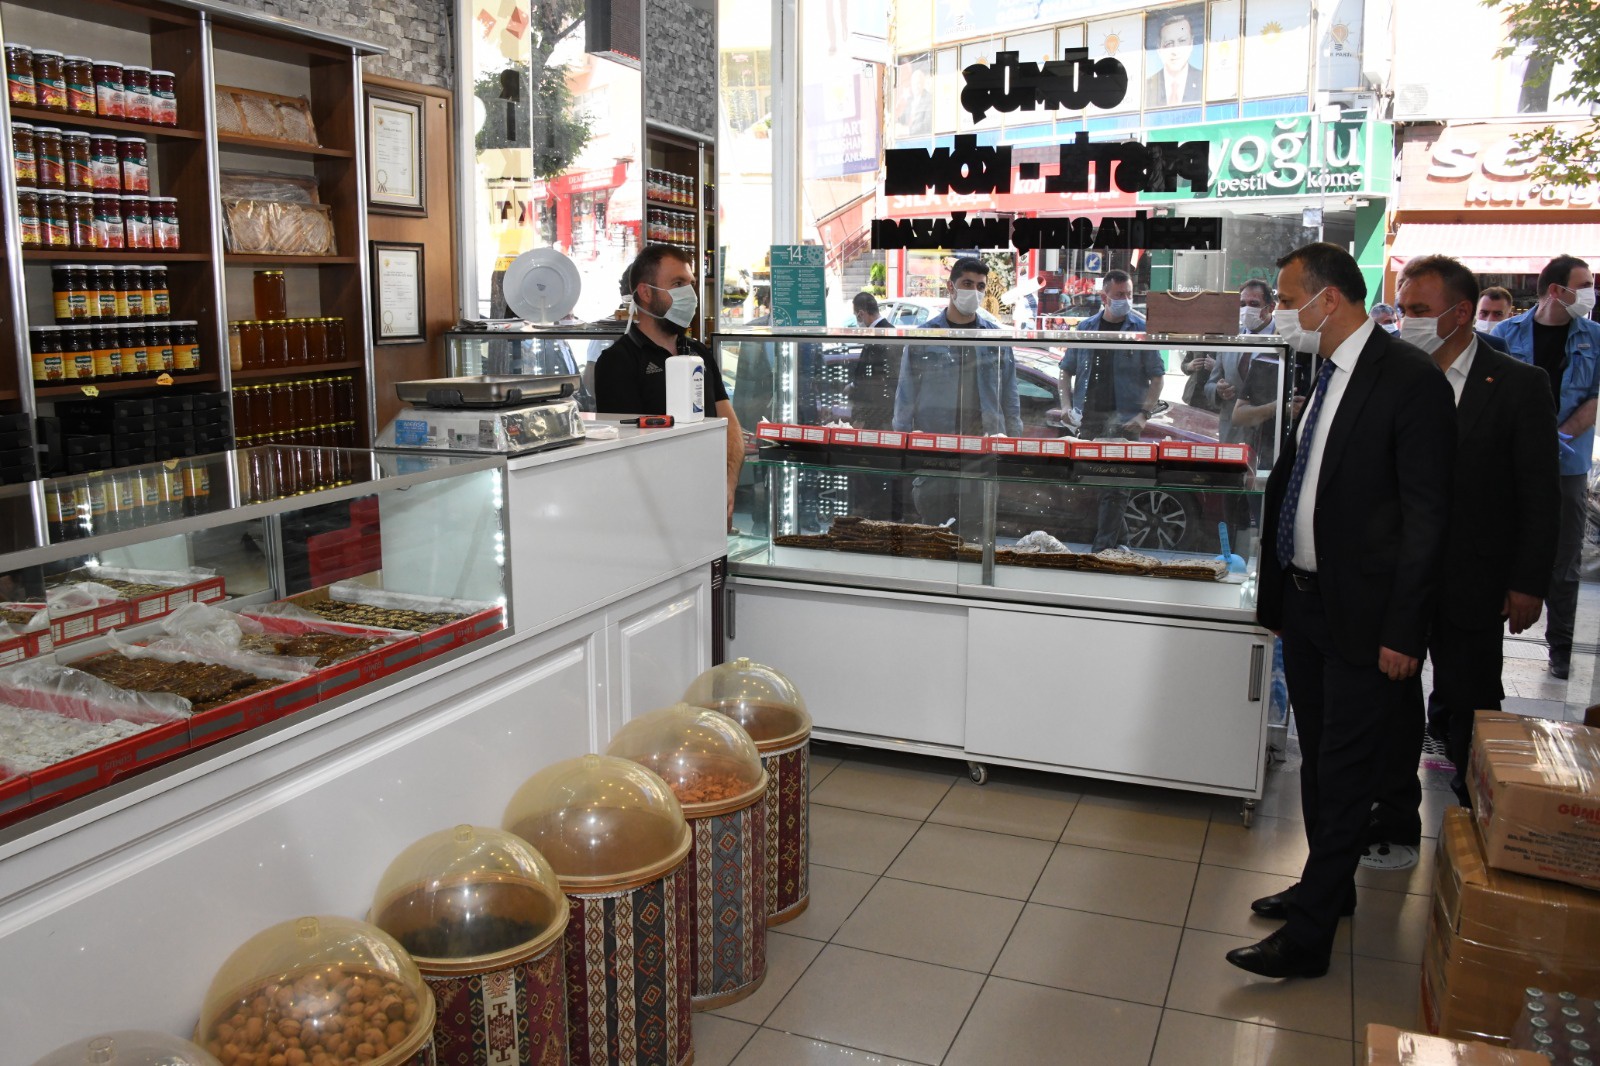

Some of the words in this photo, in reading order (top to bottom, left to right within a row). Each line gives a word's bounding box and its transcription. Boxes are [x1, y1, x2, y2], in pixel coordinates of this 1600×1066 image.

[1208, 115, 1362, 188] yoğlu
[1216, 174, 1268, 198] pestil
[1307, 169, 1363, 190] köme
[787, 246, 803, 261] 14
